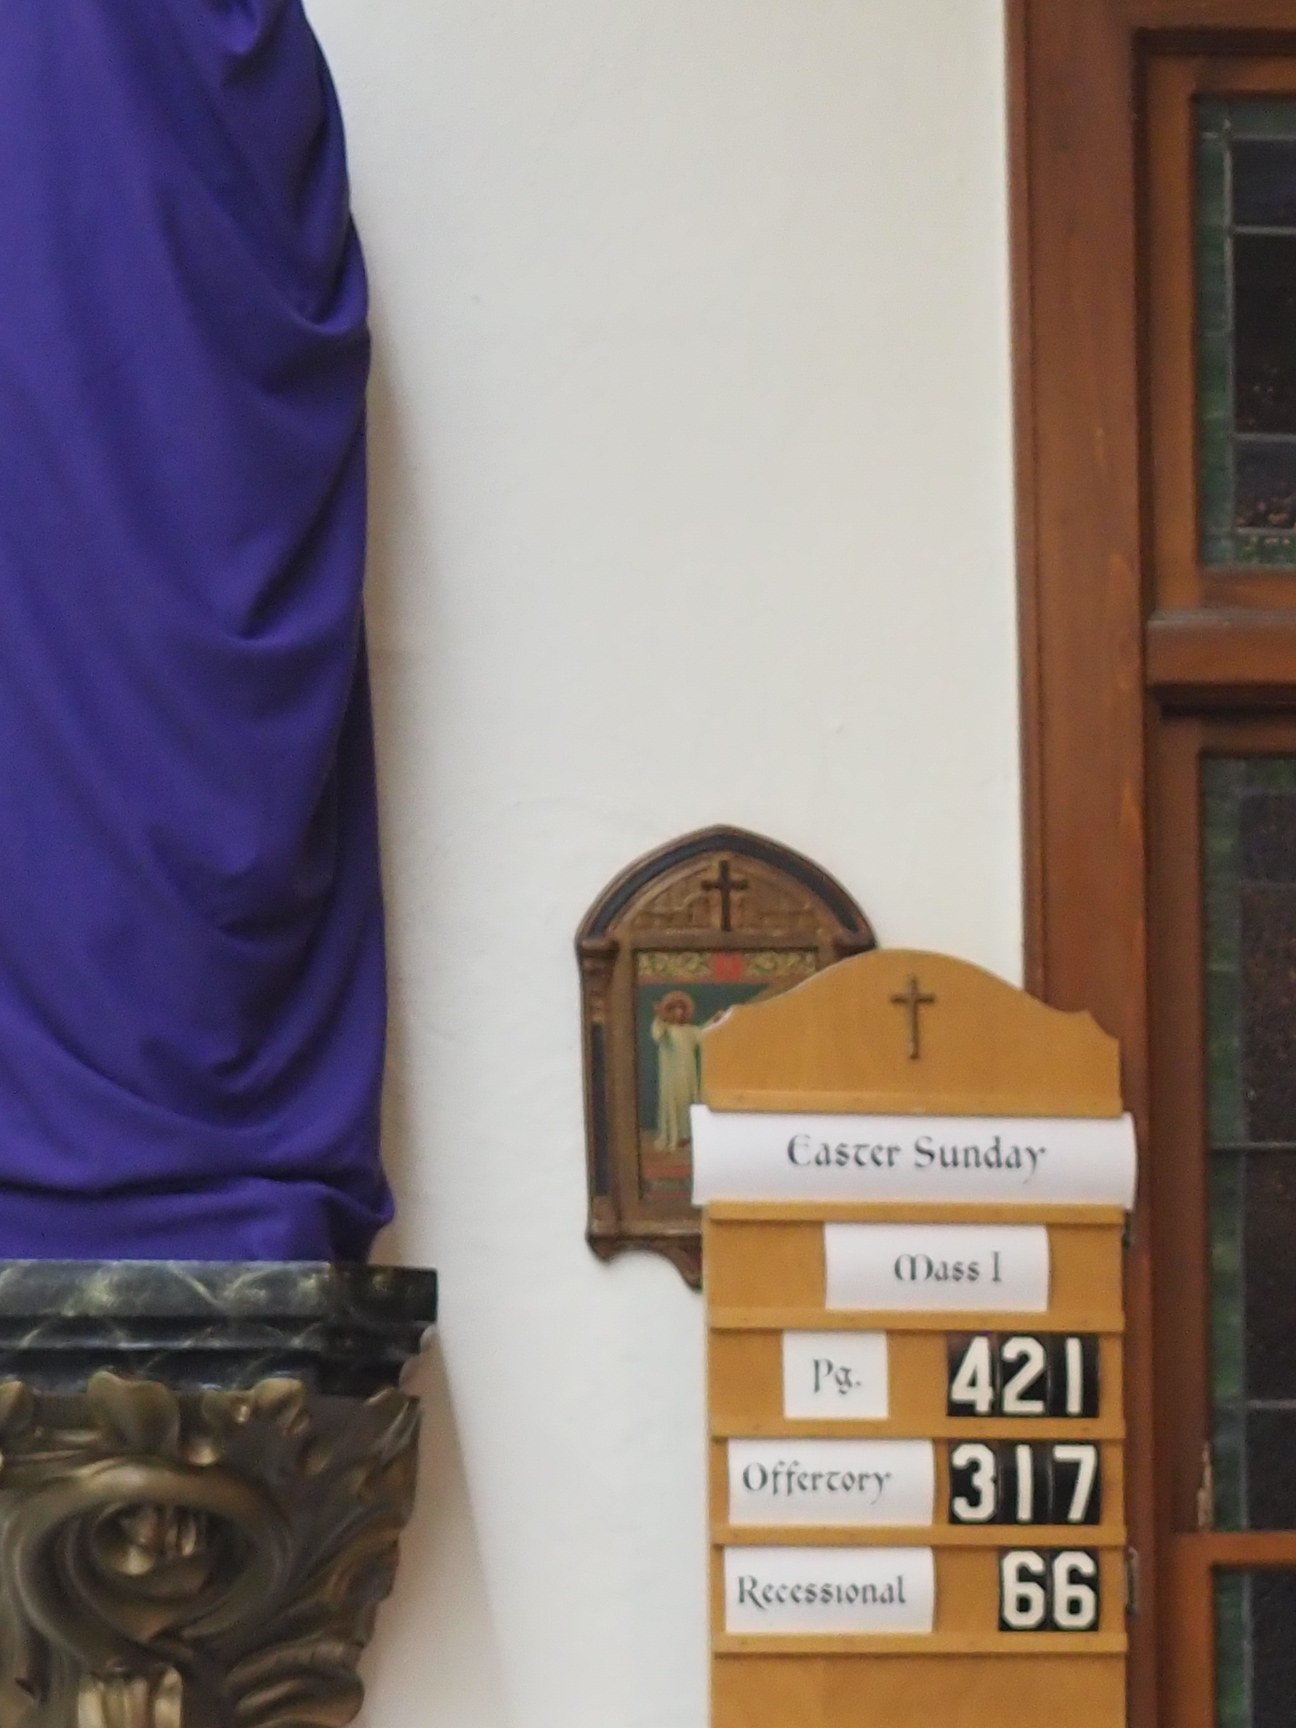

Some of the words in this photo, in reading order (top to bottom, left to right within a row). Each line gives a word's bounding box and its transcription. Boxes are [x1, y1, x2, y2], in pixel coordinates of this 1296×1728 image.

[786, 1133, 900, 1168] Easter
[914, 1135, 1047, 1184] Sunday
[894, 1253, 982, 1281] Mass
[812, 1358, 863, 1395] Pg.
[950, 1336, 1084, 1416] 421
[742, 1460, 892, 1505] Offertory
[950, 1443, 1098, 1523] 317
[737, 1574, 908, 1611] Recessional
[1001, 1550, 1098, 1630] 66
